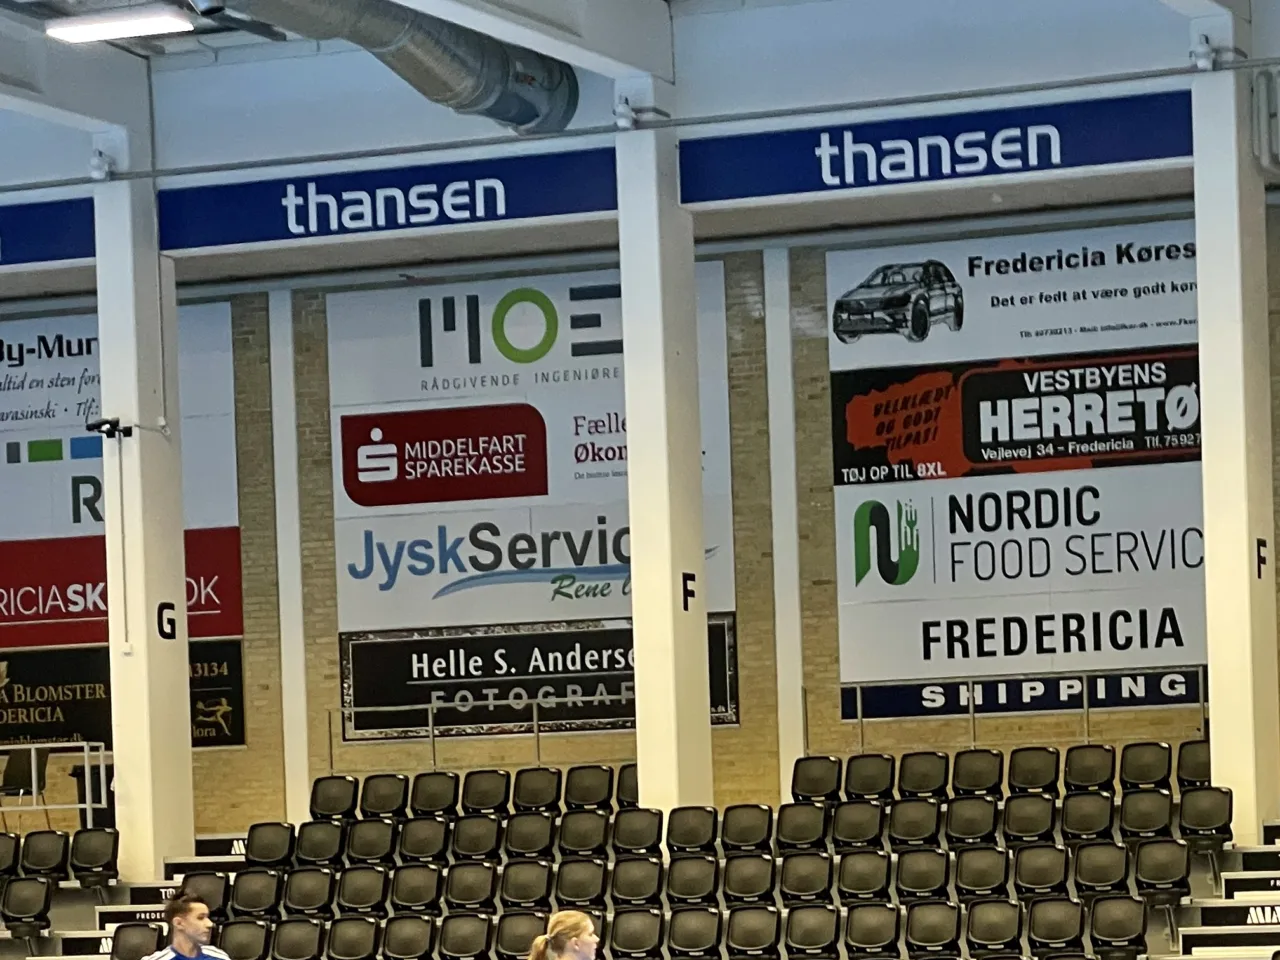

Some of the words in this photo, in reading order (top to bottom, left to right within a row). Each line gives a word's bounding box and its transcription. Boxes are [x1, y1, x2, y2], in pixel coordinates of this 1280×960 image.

[815, 124, 1061, 186] thansen
[281, 177, 507, 234] thansen
[968, 247, 1106, 278] Fredericia
[990, 294, 1016, 308] Det
[1020, 295, 1035, 306] er
[1039, 290, 1068, 304] fedt
[1072, 289, 1087, 302] at
[1092, 286, 1129, 300] være
[1133, 281, 1166, 299] godt
[418, 284, 624, 367] MOE
[0, 334, 98, 367] y-Mur
[420, 372, 520, 392] RÅDGIVENDE
[534, 366, 620, 384] INGENIØRE
[1023, 362, 1167, 394] VESTBYENS
[979, 382, 1199, 444] HERRETØ
[405, 433, 527, 461] MIDDELFART
[982, 445, 1032, 461] Vejlevej
[1037, 442, 1054, 457] 34
[1068, 438, 1134, 455] Fredericia
[405, 454, 526, 480] SPAREKASSE
[842, 467, 866, 483] TØJ
[870, 466, 889, 479] OP
[892, 464, 914, 479] TIL
[72, 476, 104, 523] R
[948, 485, 1100, 534] NORDIC
[950, 536, 1051, 583] FOOD
[1256, 538, 1267, 579] F
[551, 573, 612, 601] Rene
[682, 572, 696, 612] F
[157, 602, 176, 639] G
[922, 607, 1184, 661] FREDERICIA
[411, 649, 483, 680] Helle
[495, 647, 516, 676] S.
[922, 673, 1188, 710] SHIPPING
